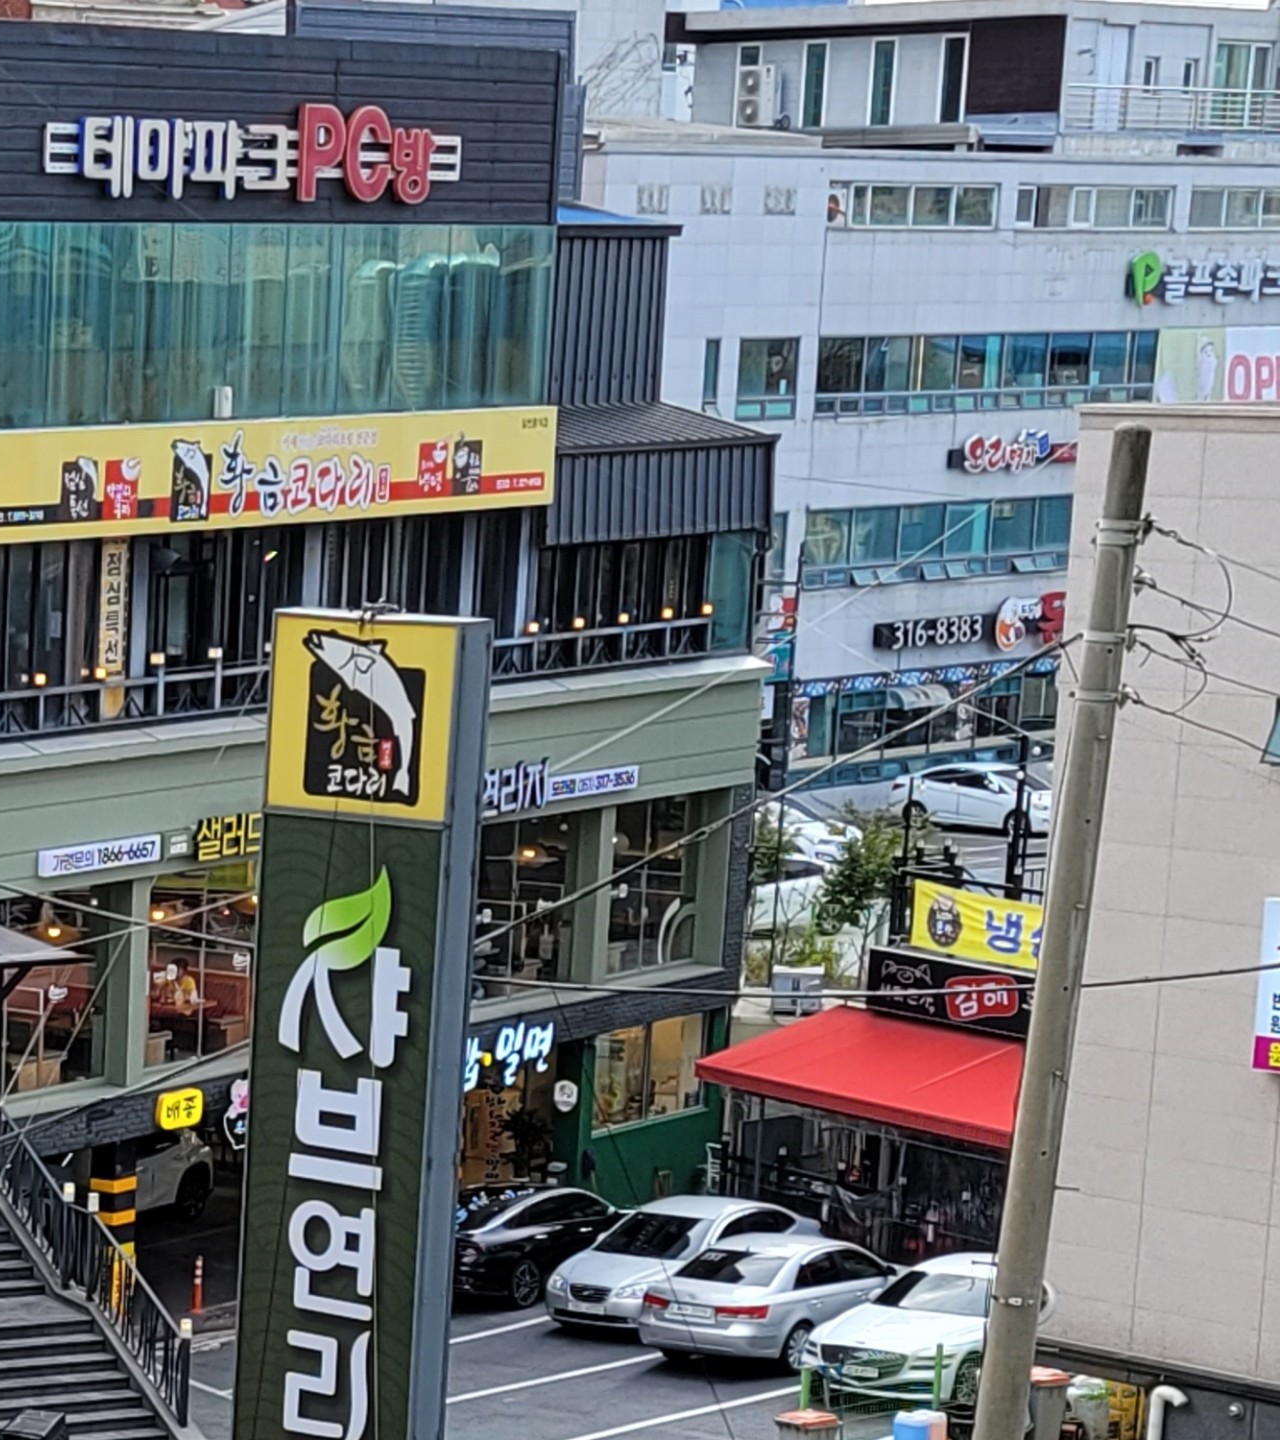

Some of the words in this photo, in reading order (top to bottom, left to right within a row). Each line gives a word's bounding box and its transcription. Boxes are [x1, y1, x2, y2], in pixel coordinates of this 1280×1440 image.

[295, 101, 436, 205] PC방
[104, 551, 123, 665] 점심특선
[892, 614, 983, 650] 316-8383
